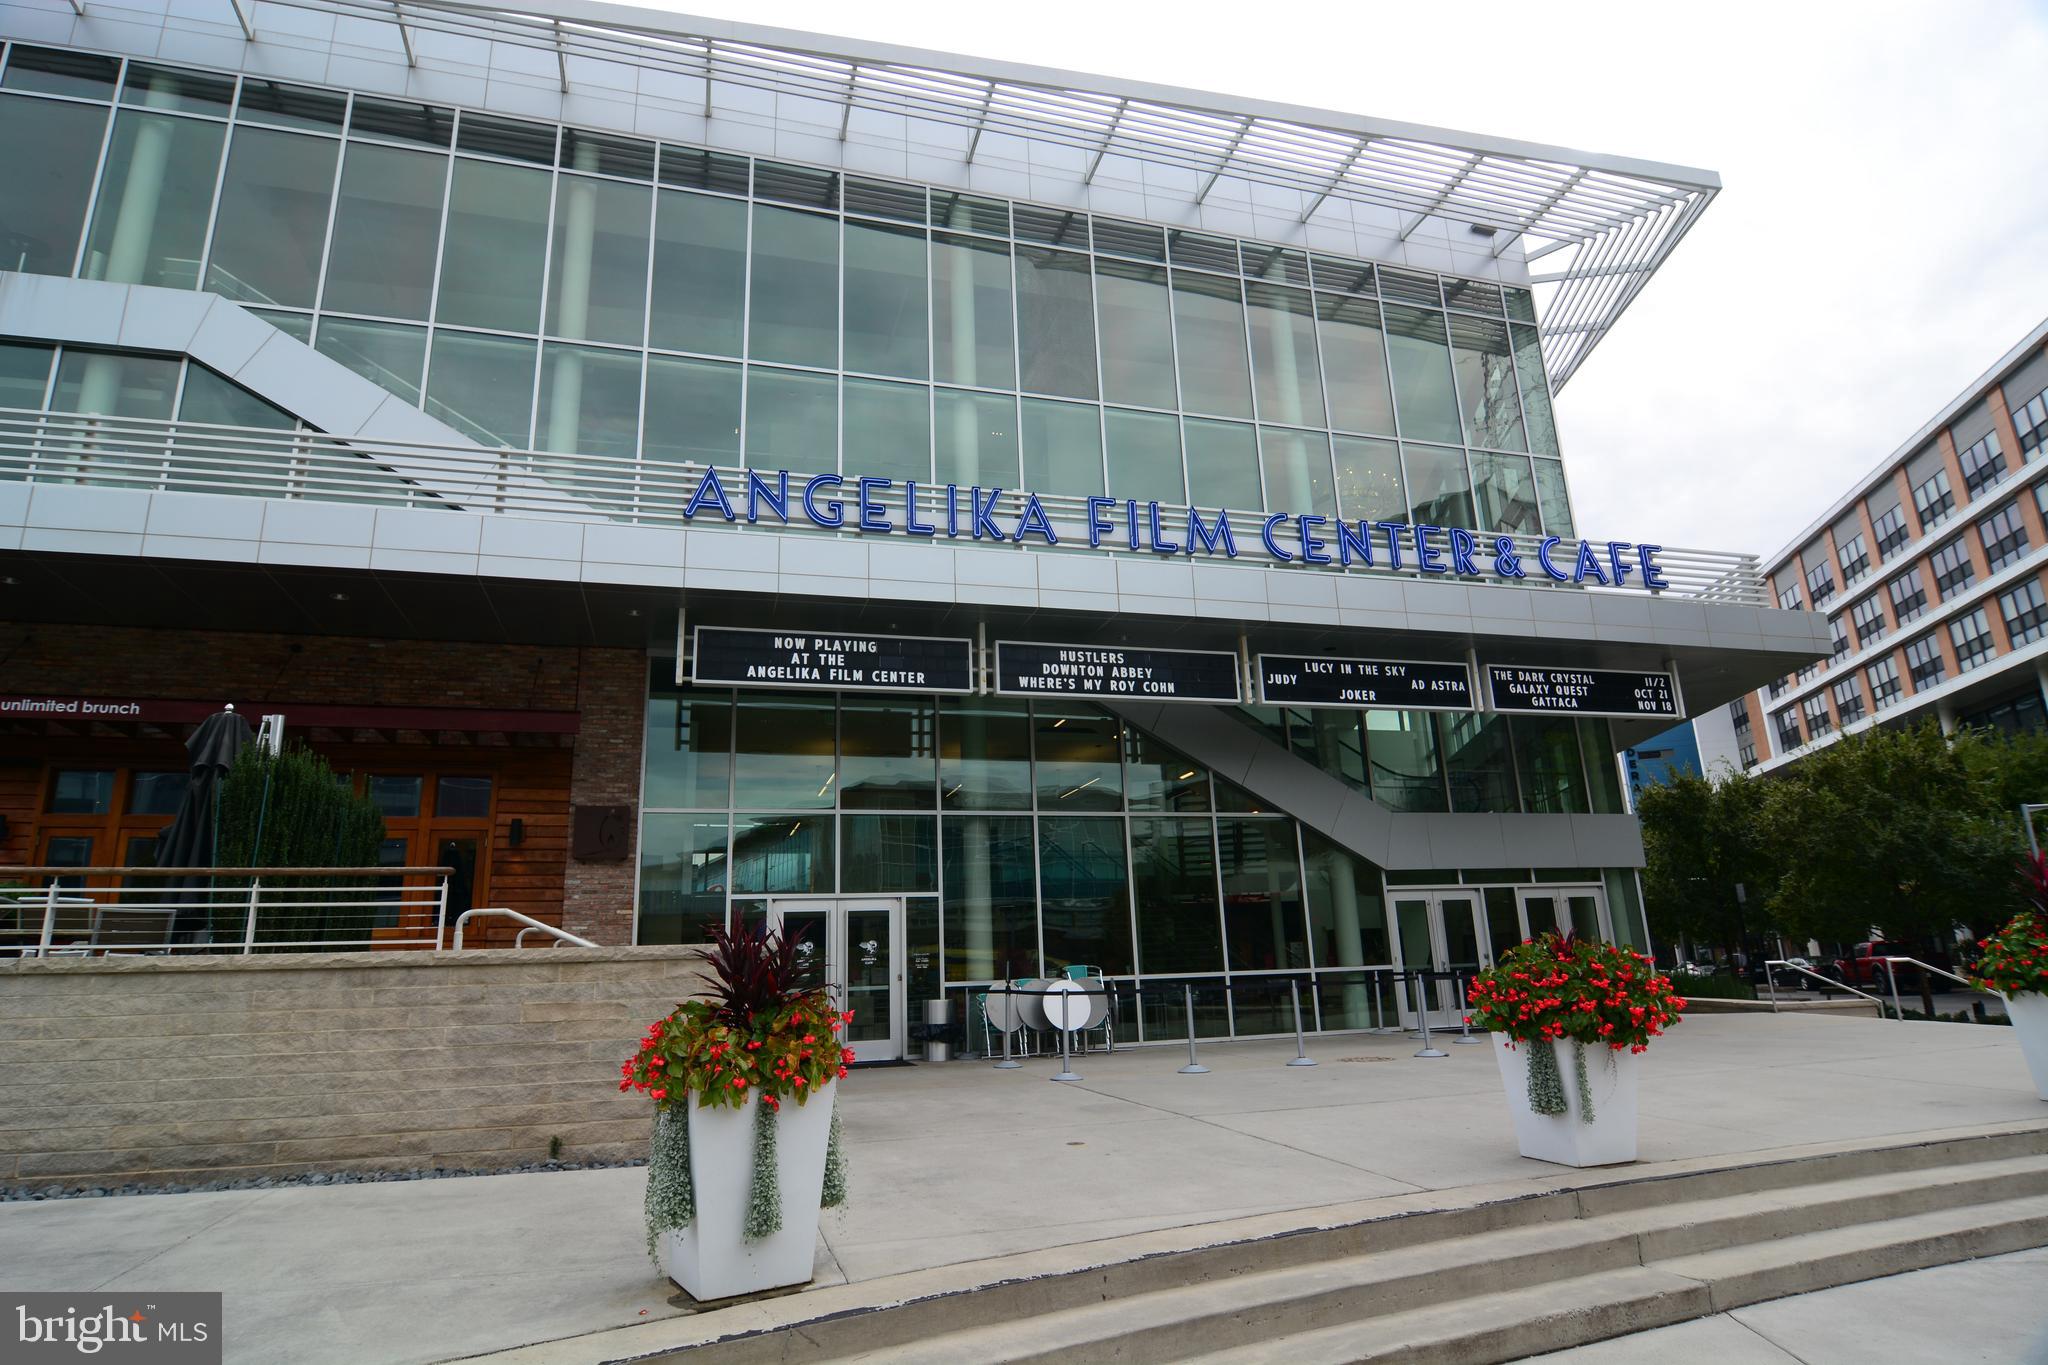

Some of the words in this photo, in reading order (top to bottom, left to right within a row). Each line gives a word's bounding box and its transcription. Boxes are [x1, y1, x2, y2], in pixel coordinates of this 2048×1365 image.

[683, 465, 1058, 545] ANGELIKA
[1087, 495, 1238, 558] FILM
[1261, 512, 1480, 576] CENTER
[1494, 536, 1527, 579] &
[1538, 535, 1670, 589] CAFE
[774, 637, 806, 650] NOW
[814, 638, 877, 653] PLAYING
[790, 653, 810, 665] AT
[819, 654, 845, 666] THE
[1059, 650, 1124, 664] HUSTLERS
[746, 665, 821, 680] ANGELIKA
[829, 668, 863, 681] FILM
[871, 670, 926, 684] CENTER
[1042, 663, 1104, 676] DOWNTON
[1111, 666, 1153, 679] ABBEY
[1304, 662, 1334, 674] LUCY
[1340, 663, 1352, 675] IN
[1358, 664, 1379, 676] THE
[1385, 665, 1406, 677] SKY
[1018, 676, 1076, 690] WHERE'S
[1083, 678, 1102, 691] MY
[1110, 680, 1136, 692] ROY
[1142, 681, 1175, 694] COHN
[1267, 673, 1298, 685] JUDY
[1411, 679, 1426, 690] AD
[1431, 680, 1466, 692] ASTRA
[1494, 670, 1513, 681] THE
[1518, 671, 1546, 683] DARK
[1550, 672, 1595, 685] CRYSTAL
[1644, 677, 1665, 688] 11/2
[1339, 689, 1377, 701] JOKER
[1509, 683, 1550, 695] GALAXY
[1555, 685, 1589, 697] QUEST
[1634, 688, 1653, 699] OCT
[1658, 689, 1669, 700] 21
[0, 698, 79, 713] unlimited
[81, 701, 141, 715] brunch
[1531, 696, 1578, 709] GATTACA
[1637, 700, 1657, 712] NOV
[1662, 701, 1673, 712] 18
